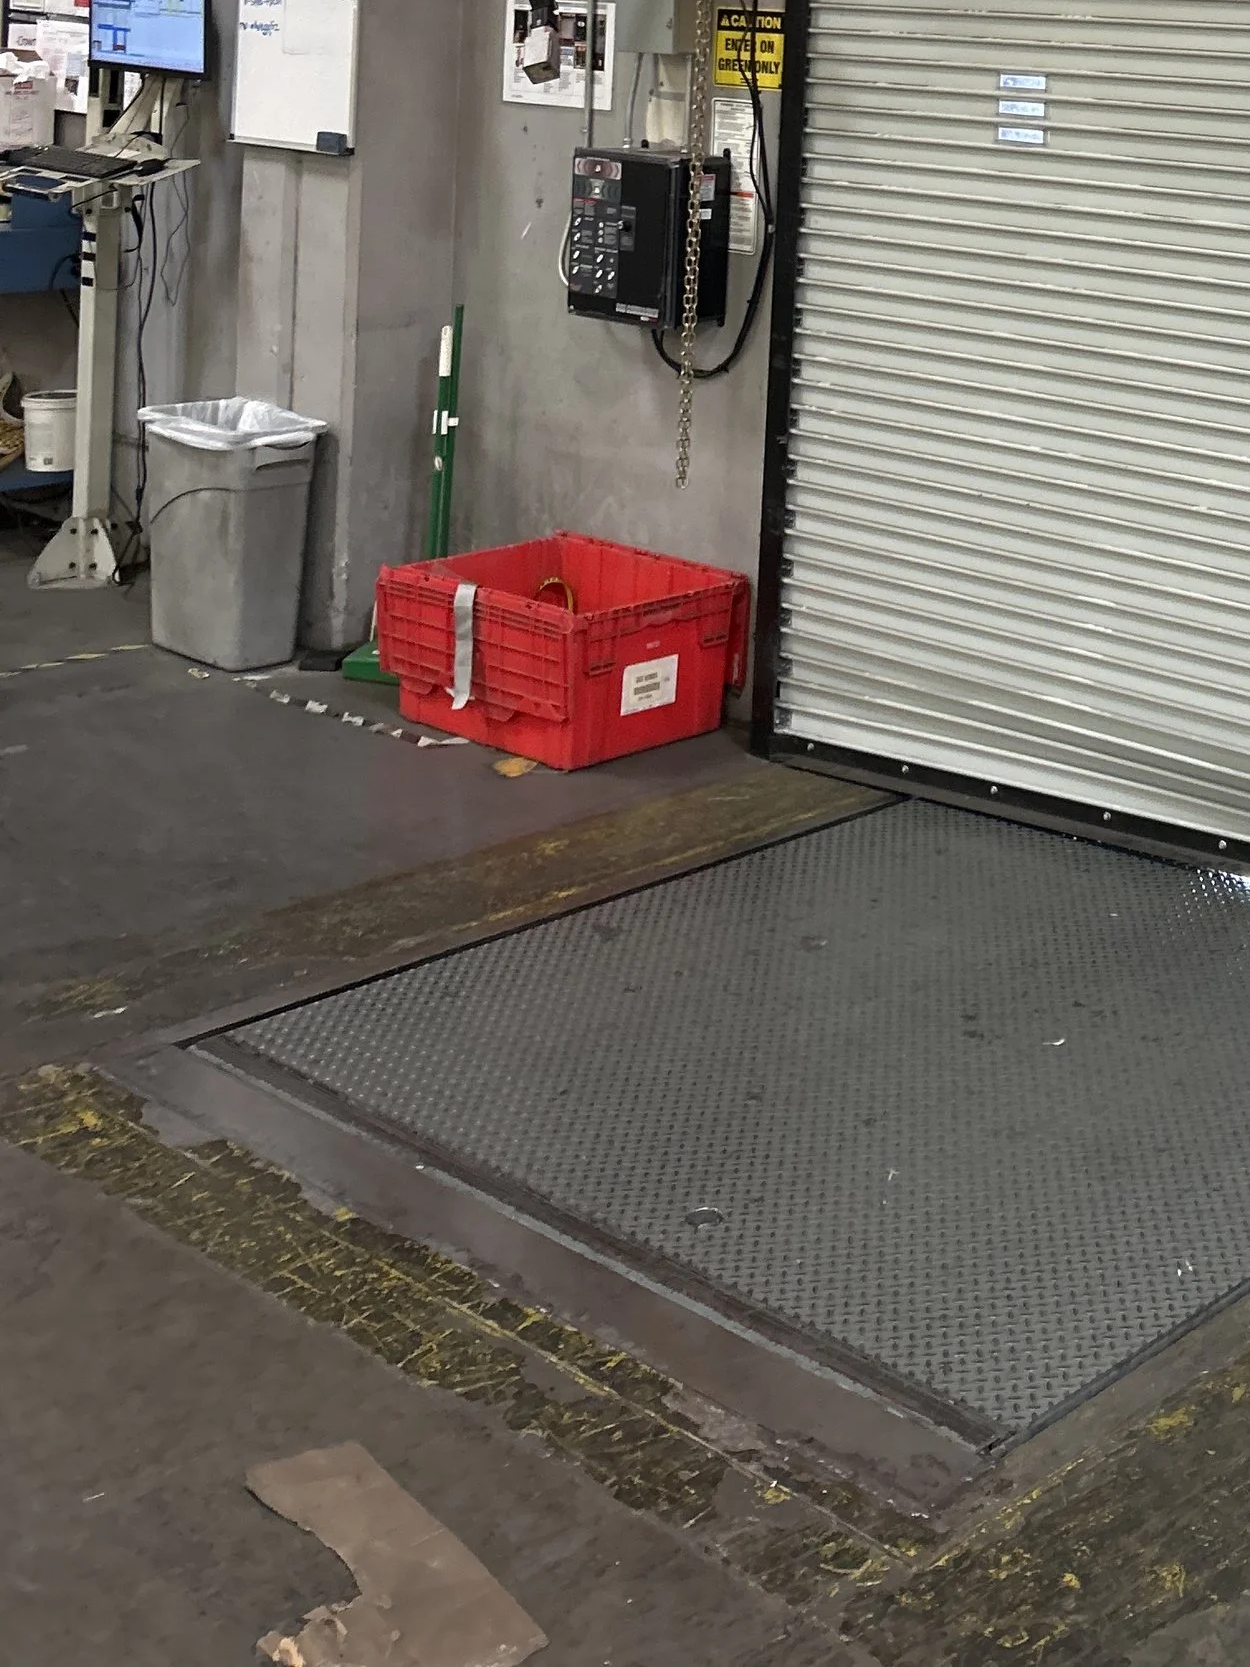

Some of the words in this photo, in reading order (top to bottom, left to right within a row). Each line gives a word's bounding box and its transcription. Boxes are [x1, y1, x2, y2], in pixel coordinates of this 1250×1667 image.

[731, 15, 781, 29] CATION
[725, 38, 755, 53] ENTE
[760, 40, 775, 54] ON
[754, 60, 781, 75] ONLY
